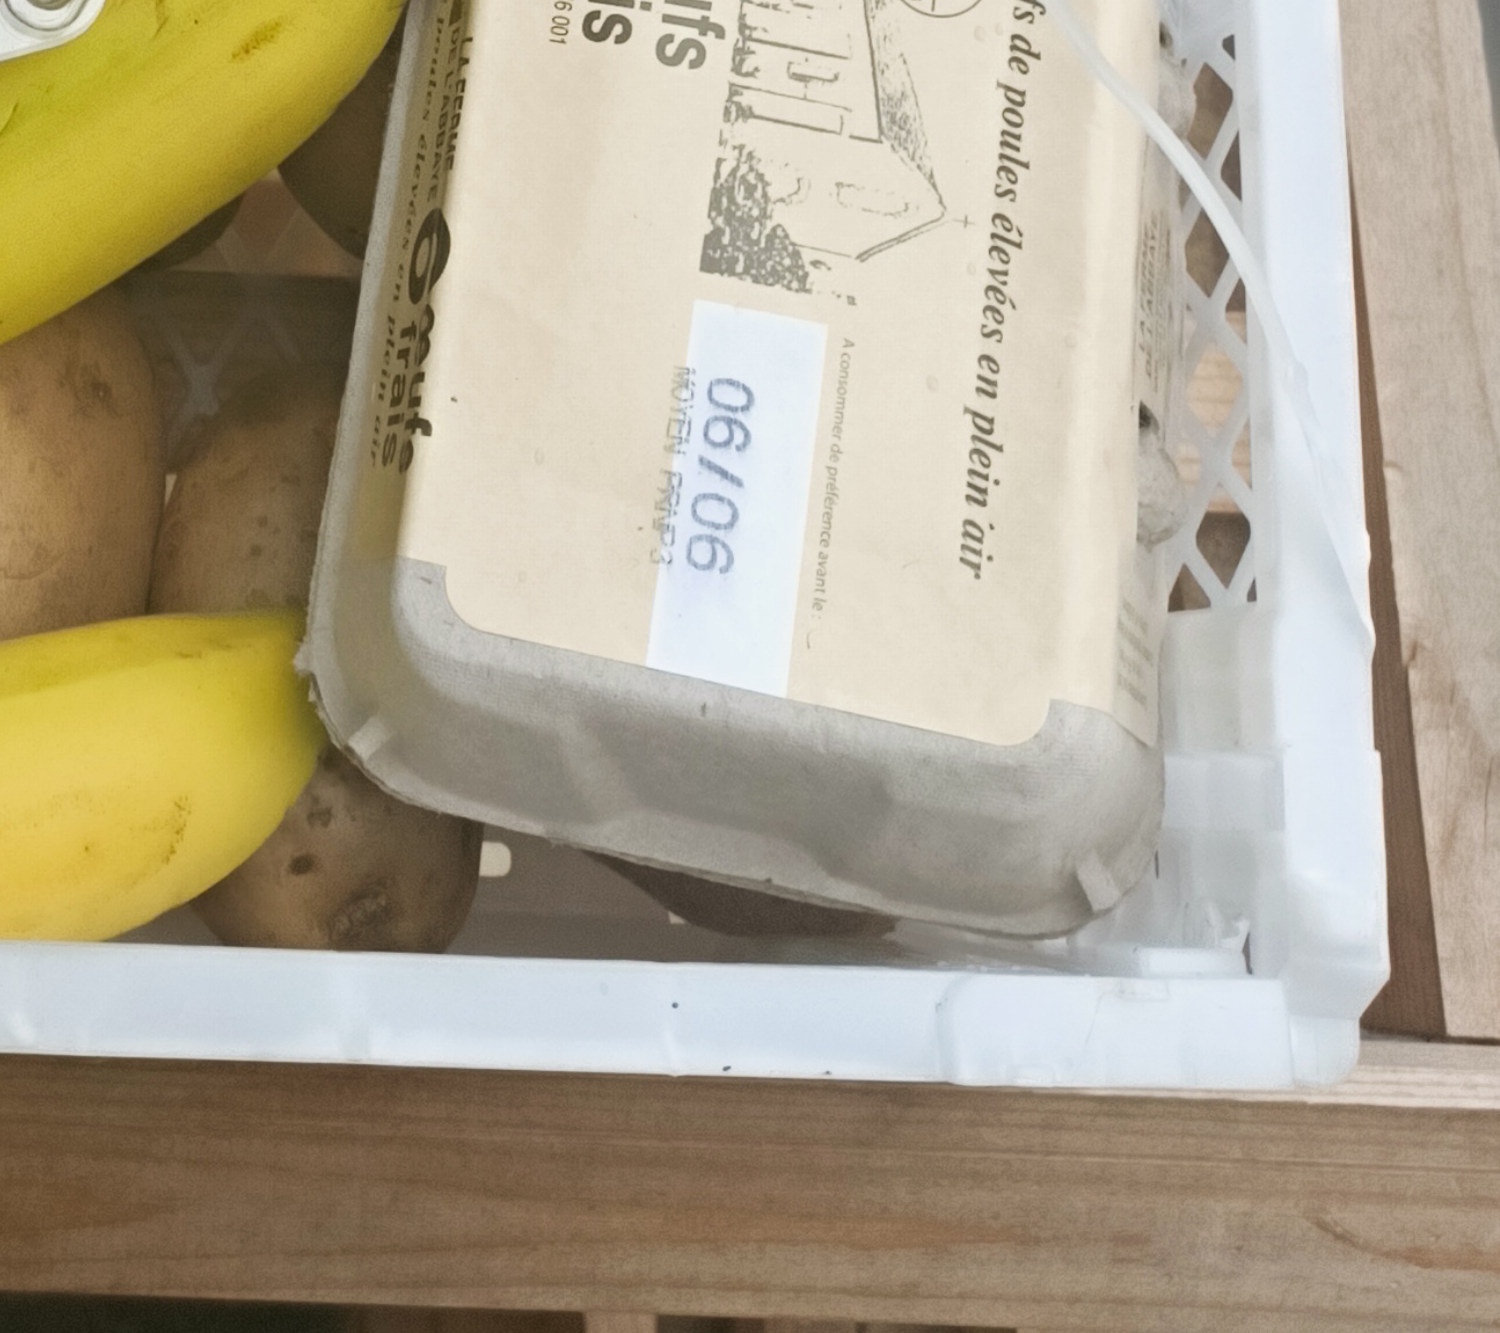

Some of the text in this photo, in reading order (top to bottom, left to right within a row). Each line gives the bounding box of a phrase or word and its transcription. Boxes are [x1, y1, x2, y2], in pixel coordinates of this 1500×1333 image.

[549, 16, 570, 45] 001
[1008, 34, 1042, 75] de
[996, 80, 1030, 203] poules
[979, 213, 1024, 344] élevées
[842, 338, 855, 349] A
[975, 354, 1001, 400] en
[382, 321, 417, 468] frais
[663, 366, 697, 455] MOYEN
[830, 353, 850, 441] consommer
[686, 378, 755, 575] 06/06
[829, 444, 843, 463] de
[963, 406, 1004, 507] plein
[819, 465, 840, 548] préférence
[813, 551, 829, 593] avant
[958, 519, 994, 580] air
[812, 597, 827, 611] le
